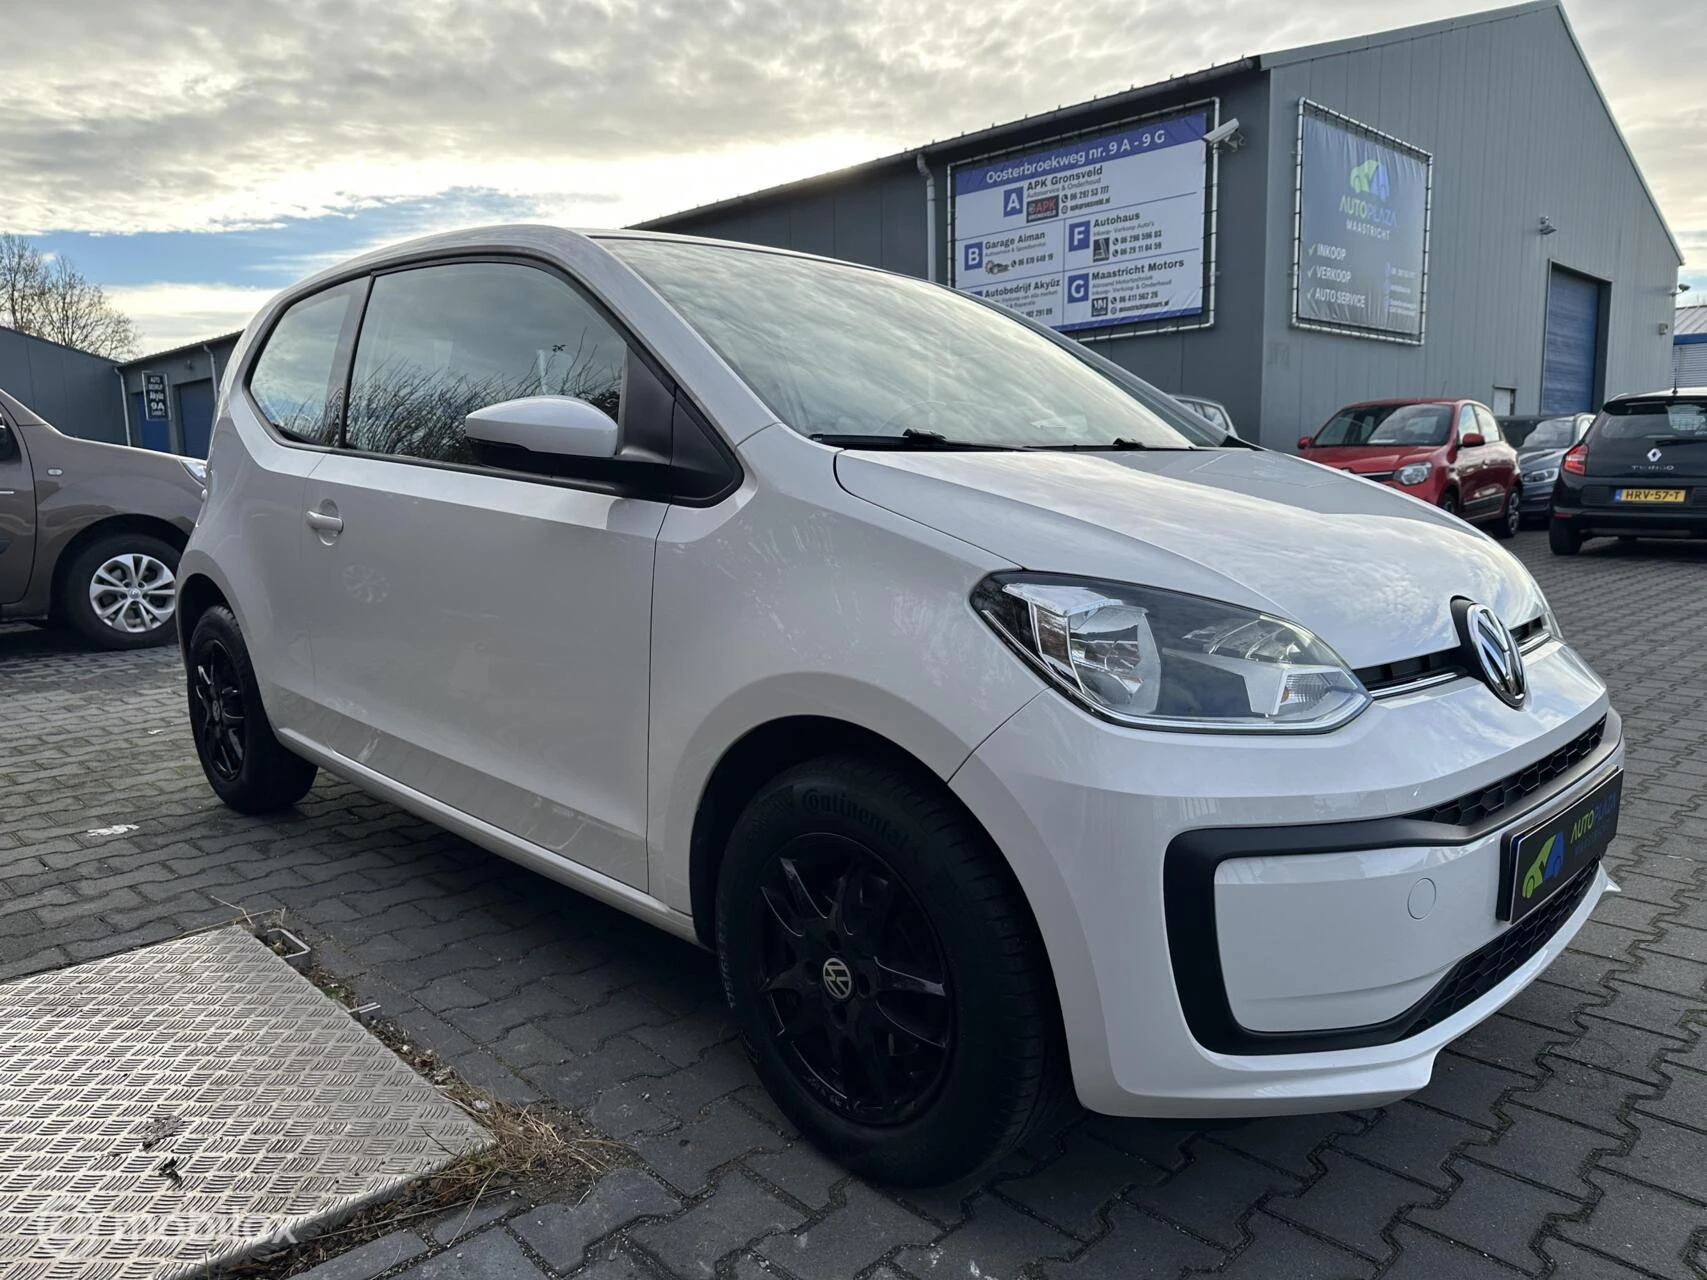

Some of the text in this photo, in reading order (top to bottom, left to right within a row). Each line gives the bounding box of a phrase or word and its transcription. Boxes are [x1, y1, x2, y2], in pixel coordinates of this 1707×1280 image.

[986, 150, 1085, 183] Oosterbroekweg
[1089, 148, 1106, 160] nr.
[1109, 142, 1117, 154] 9
[1120, 139, 1131, 152] A
[1142, 133, 1151, 147] 9
[1154, 130, 1165, 143] G
[1027, 165, 1103, 191] APK Gronsveld
[1007, 192, 1020, 212] A
[1093, 212, 1140, 228] Autohaus
[1073, 226, 1086, 246] F
[1345, 220, 1391, 242] MAASTRICHT
[985, 237, 1015, 250] Garage
[1017, 232, 1045, 244] Aiman
[968, 247, 980, 266] B
[1316, 243, 1347, 261] INKOOP
[1091, 260, 1184, 281] Maastricht Motors
[1316, 265, 1351, 284] VERKOOP
[984, 279, 1061, 298] Autobedrijf Akyüz
[1071, 279, 1085, 298] G
[1314, 286, 1366, 308] AUTO SERVICE
[150, 401, 165, 410] 9A
[1625, 489, 1681, 500] HRV-57-T
[801, 788, 910, 852] Continental
